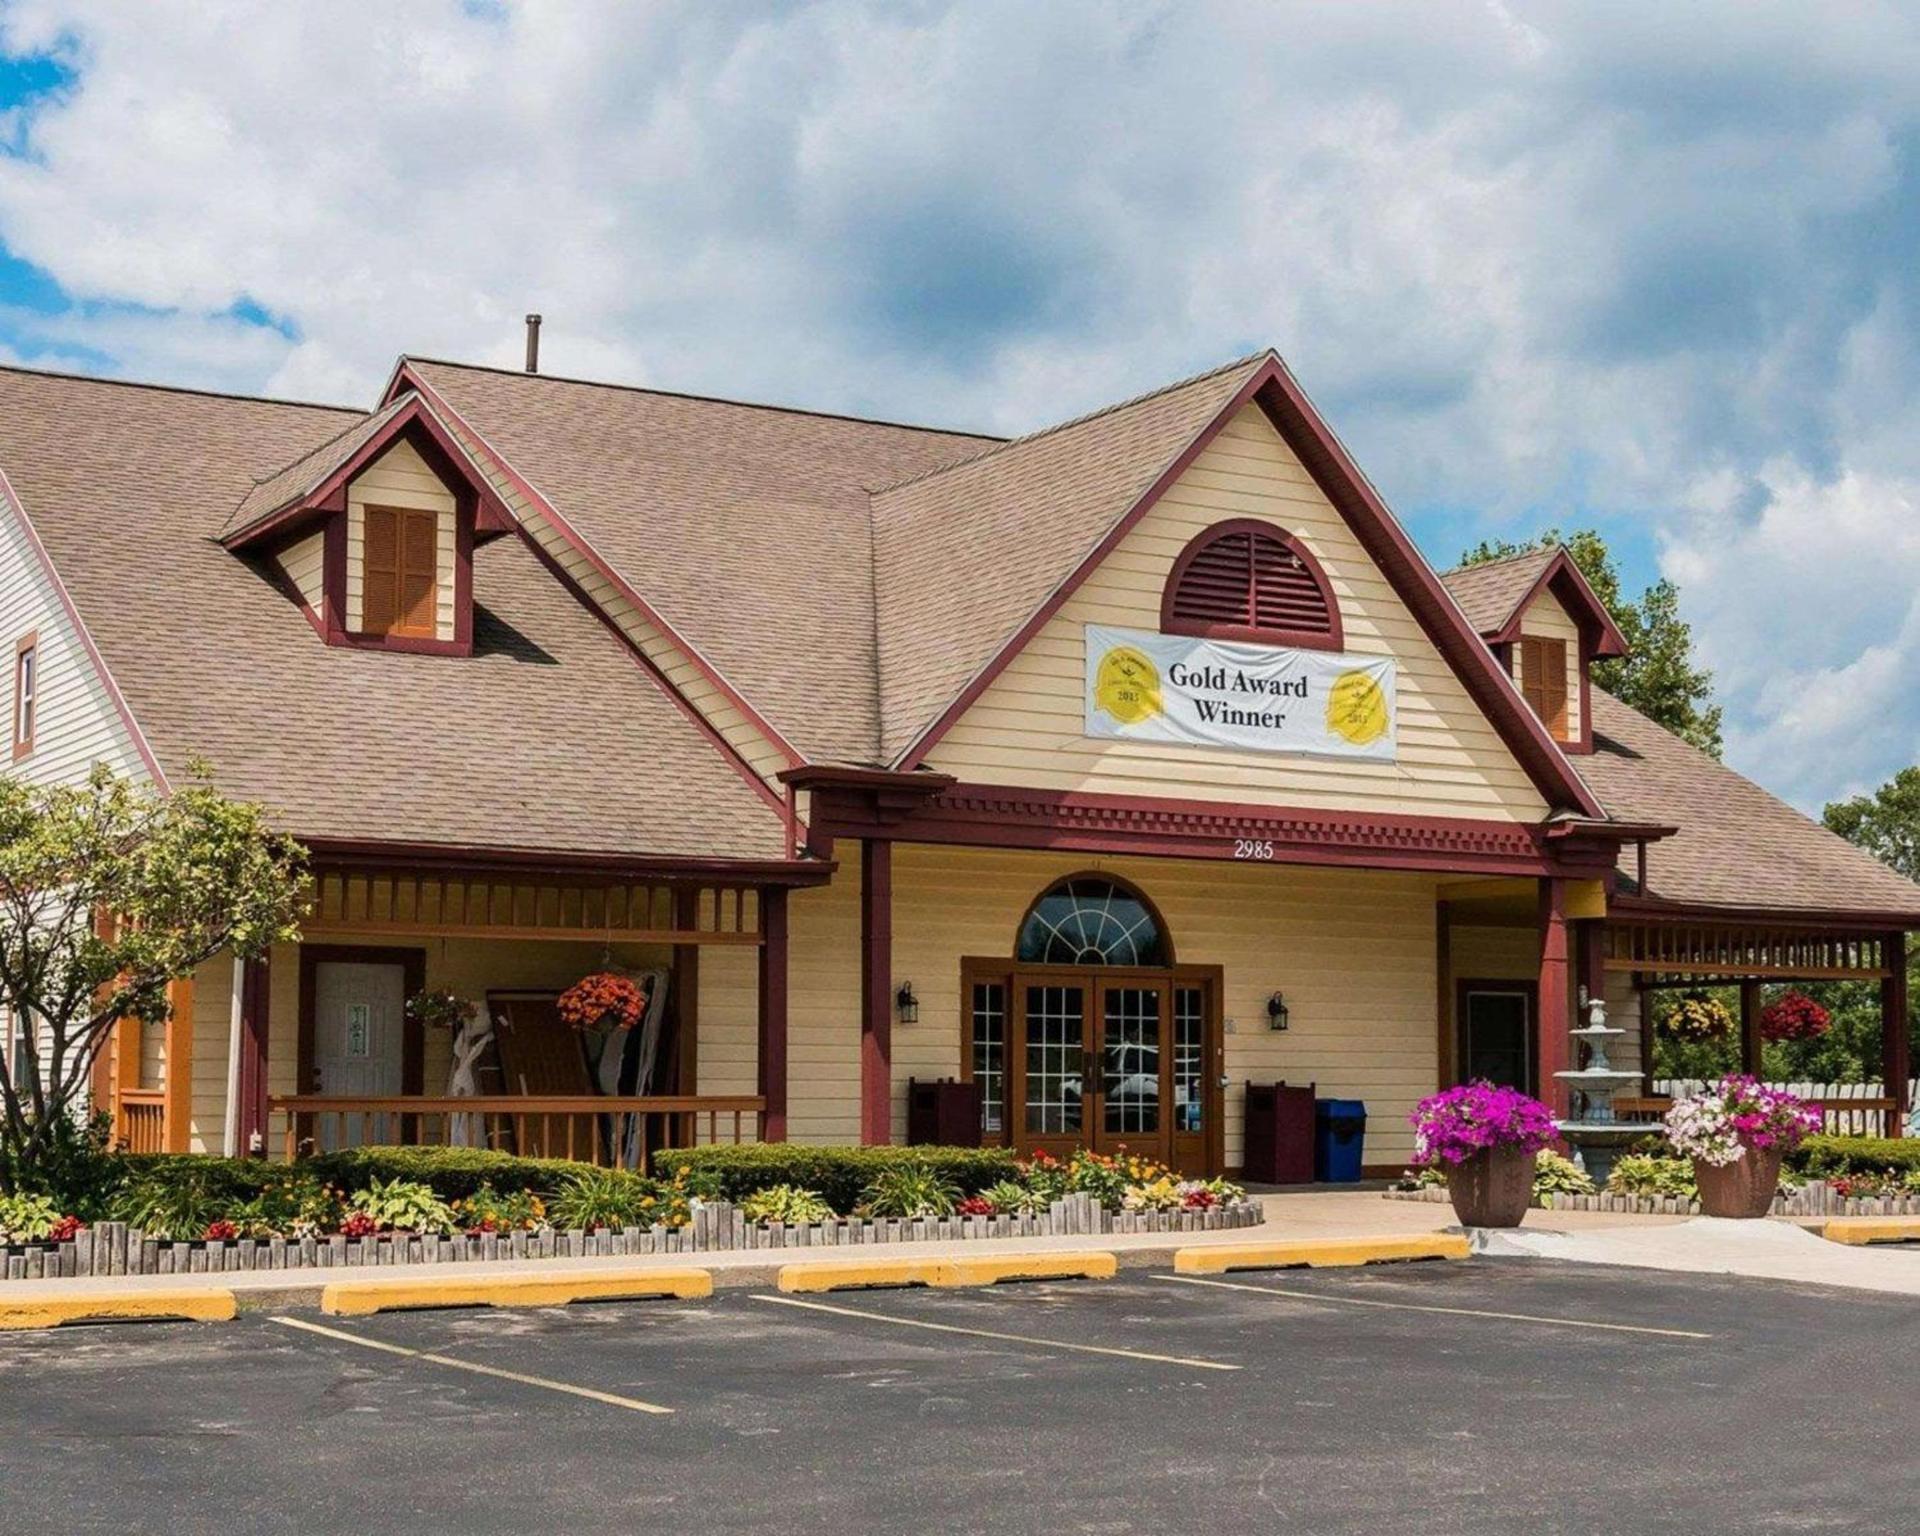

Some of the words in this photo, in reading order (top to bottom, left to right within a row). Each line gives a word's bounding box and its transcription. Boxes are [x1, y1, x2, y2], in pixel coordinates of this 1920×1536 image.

[1169, 664, 1225, 691] Gold
[1231, 673, 1308, 698] Award
[1194, 700, 1286, 729] Winner
[1234, 839, 1274, 859] 2985
